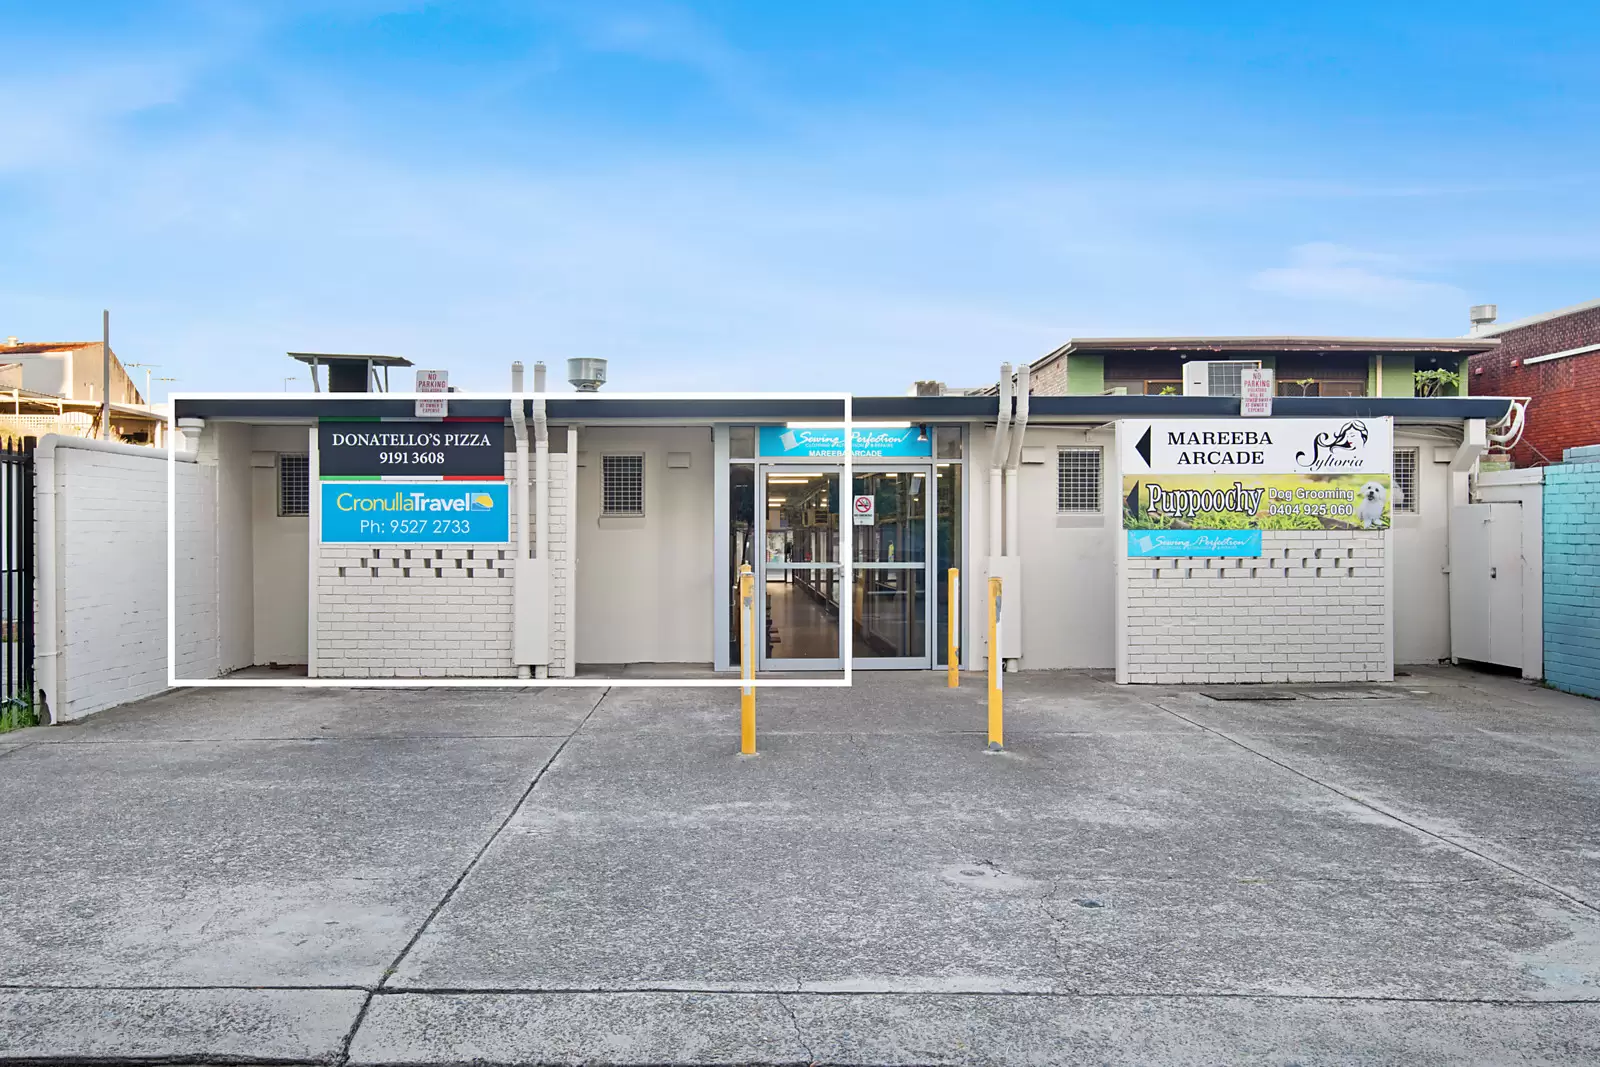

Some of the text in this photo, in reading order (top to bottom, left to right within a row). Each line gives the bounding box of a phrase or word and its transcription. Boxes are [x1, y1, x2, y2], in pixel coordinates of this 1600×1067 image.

[1253, 372, 1262, 380] NO
[418, 380, 446, 388] PARKING
[1244, 380, 1271, 388] PARKING
[332, 433, 492, 446] DONATELLO'S PIZZA
[799, 431, 906, 448] Sewing Perfection
[1167, 431, 1273, 445] MAREEBA
[379, 451, 445, 464] 9191 3608
[1177, 451, 1265, 465] ARCADE
[336, 491, 470, 512] CronullaTravel
[1145, 481, 1265, 517] Puppoochy
[1268, 487, 1354, 502] Dog Grooming
[1268, 504, 1354, 516] 0404 925 060
[360, 519, 470, 534] Ph: 9527 2733
[1155, 535, 1247, 550] Sewing Perfection
